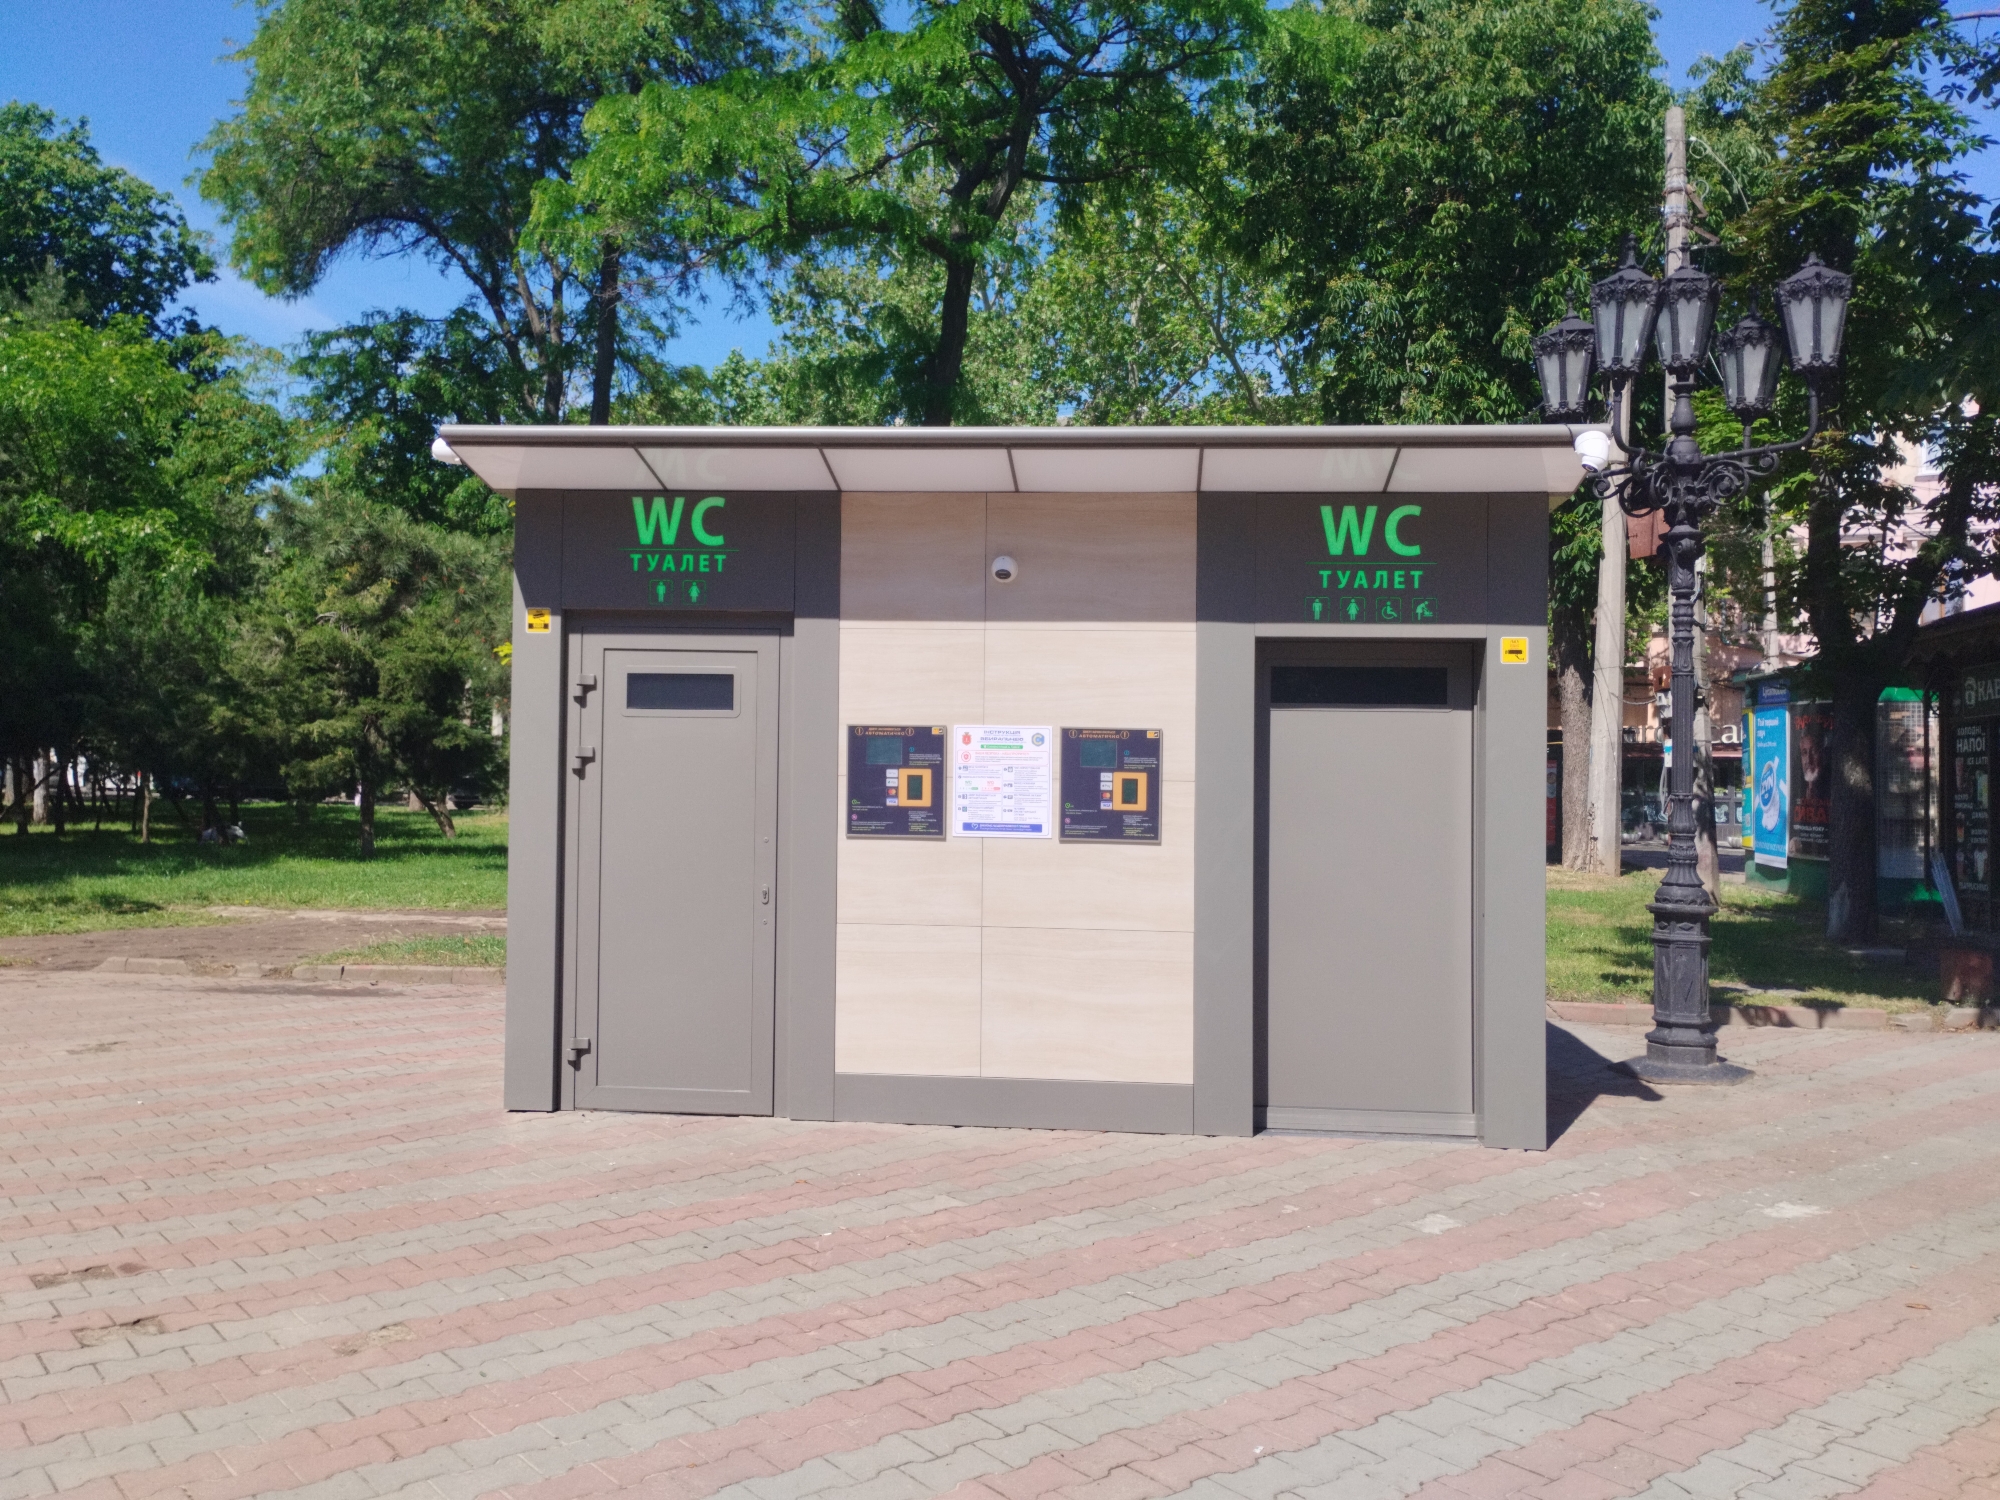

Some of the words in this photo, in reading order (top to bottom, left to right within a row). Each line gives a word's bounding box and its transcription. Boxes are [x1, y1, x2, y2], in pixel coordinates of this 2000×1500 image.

[632, 496, 726, 546] WC
[1320, 504, 1423, 557] WC
[630, 554, 727, 573] ТУАЛЕТ
[1319, 570, 1424, 590] ТУАЛЕТ
[1956, 732, 1986, 753] НАПОЇ
